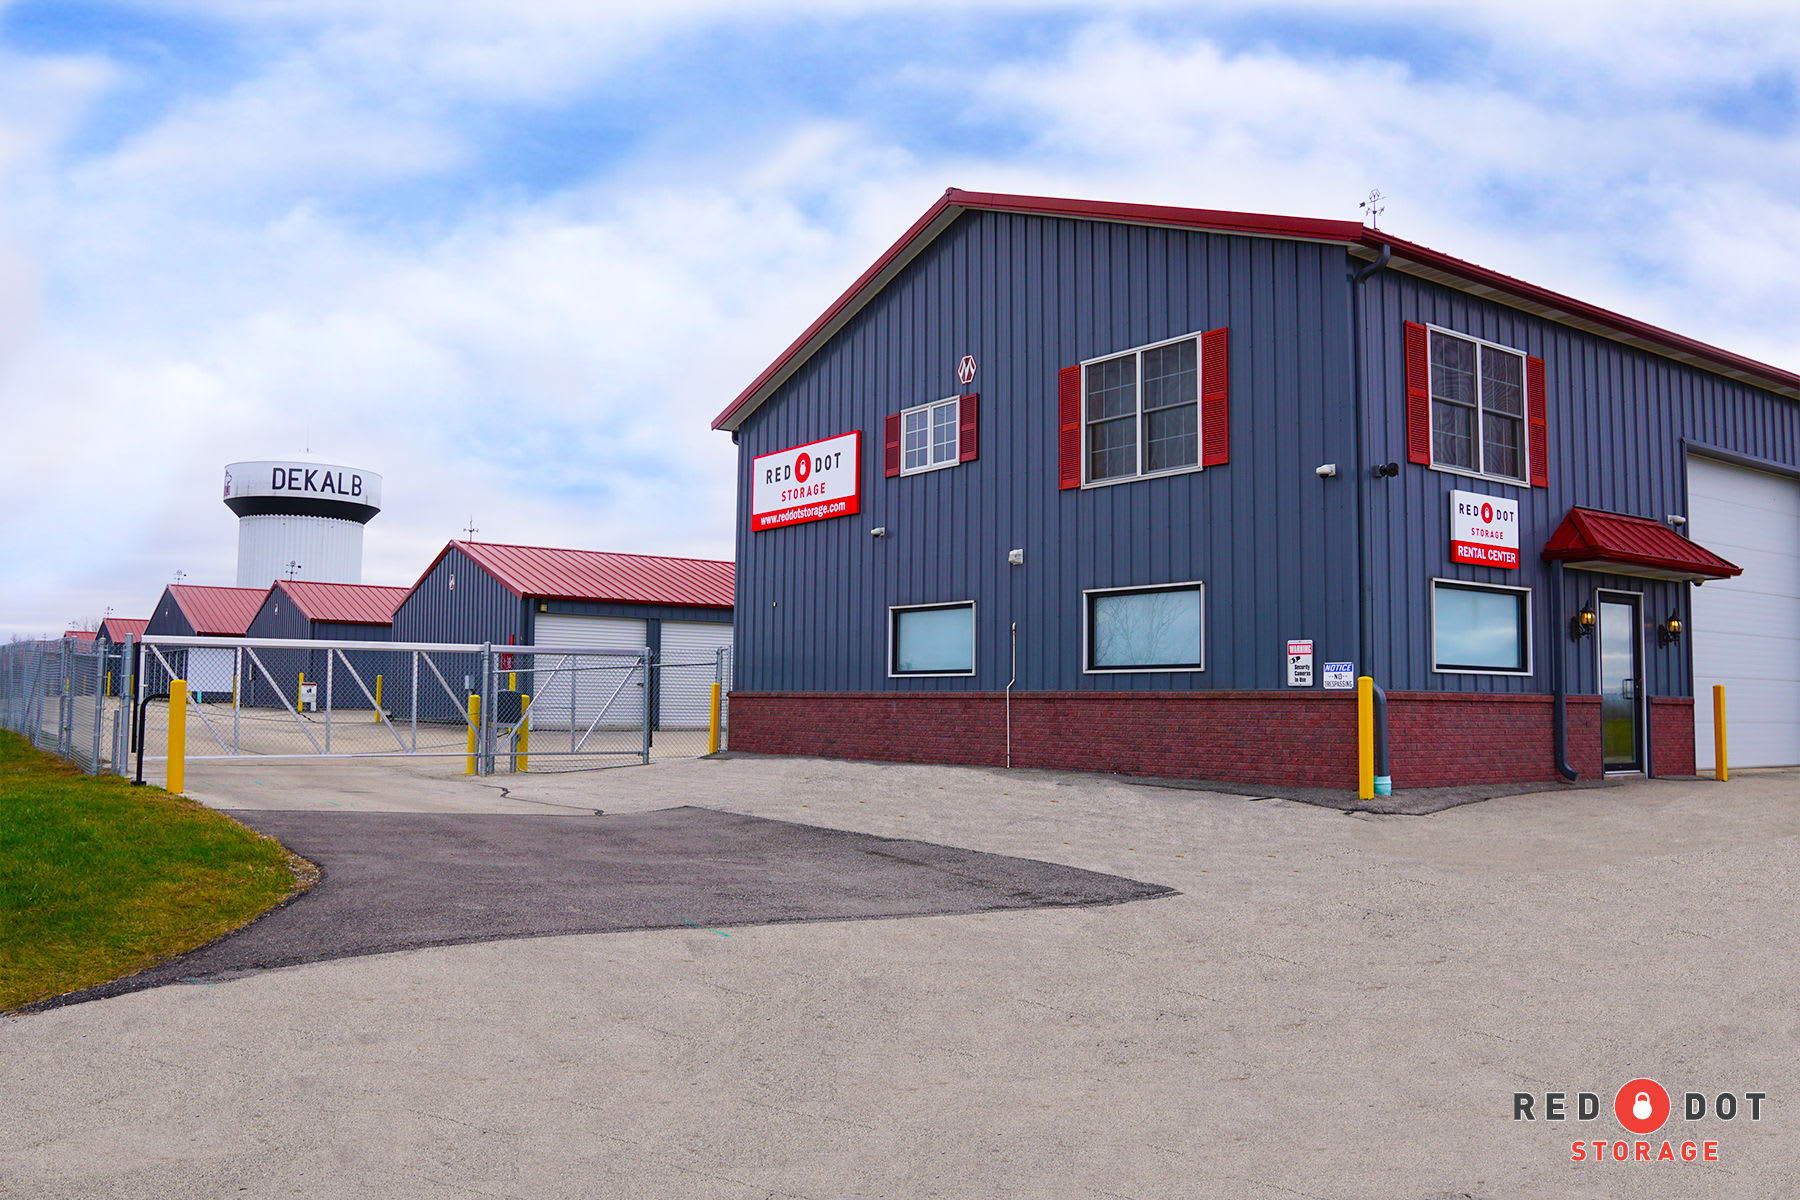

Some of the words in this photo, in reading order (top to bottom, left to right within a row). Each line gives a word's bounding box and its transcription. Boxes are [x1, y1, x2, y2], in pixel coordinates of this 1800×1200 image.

[766, 465, 791, 484] RED
[815, 452, 841, 473] DOT
[272, 467, 362, 496] DEKALB
[781, 482, 826, 502] STORAGE
[760, 502, 846, 526] www.reddotstorage.com
[1459, 503, 1479, 517] RED
[1496, 509, 1514, 522] DOT
[1471, 528, 1504, 540] STORAGE
[1458, 545, 1487, 559] RENTAL
[1488, 549, 1516, 563] CENTER
[1325, 664, 1351, 672] NOTICE
